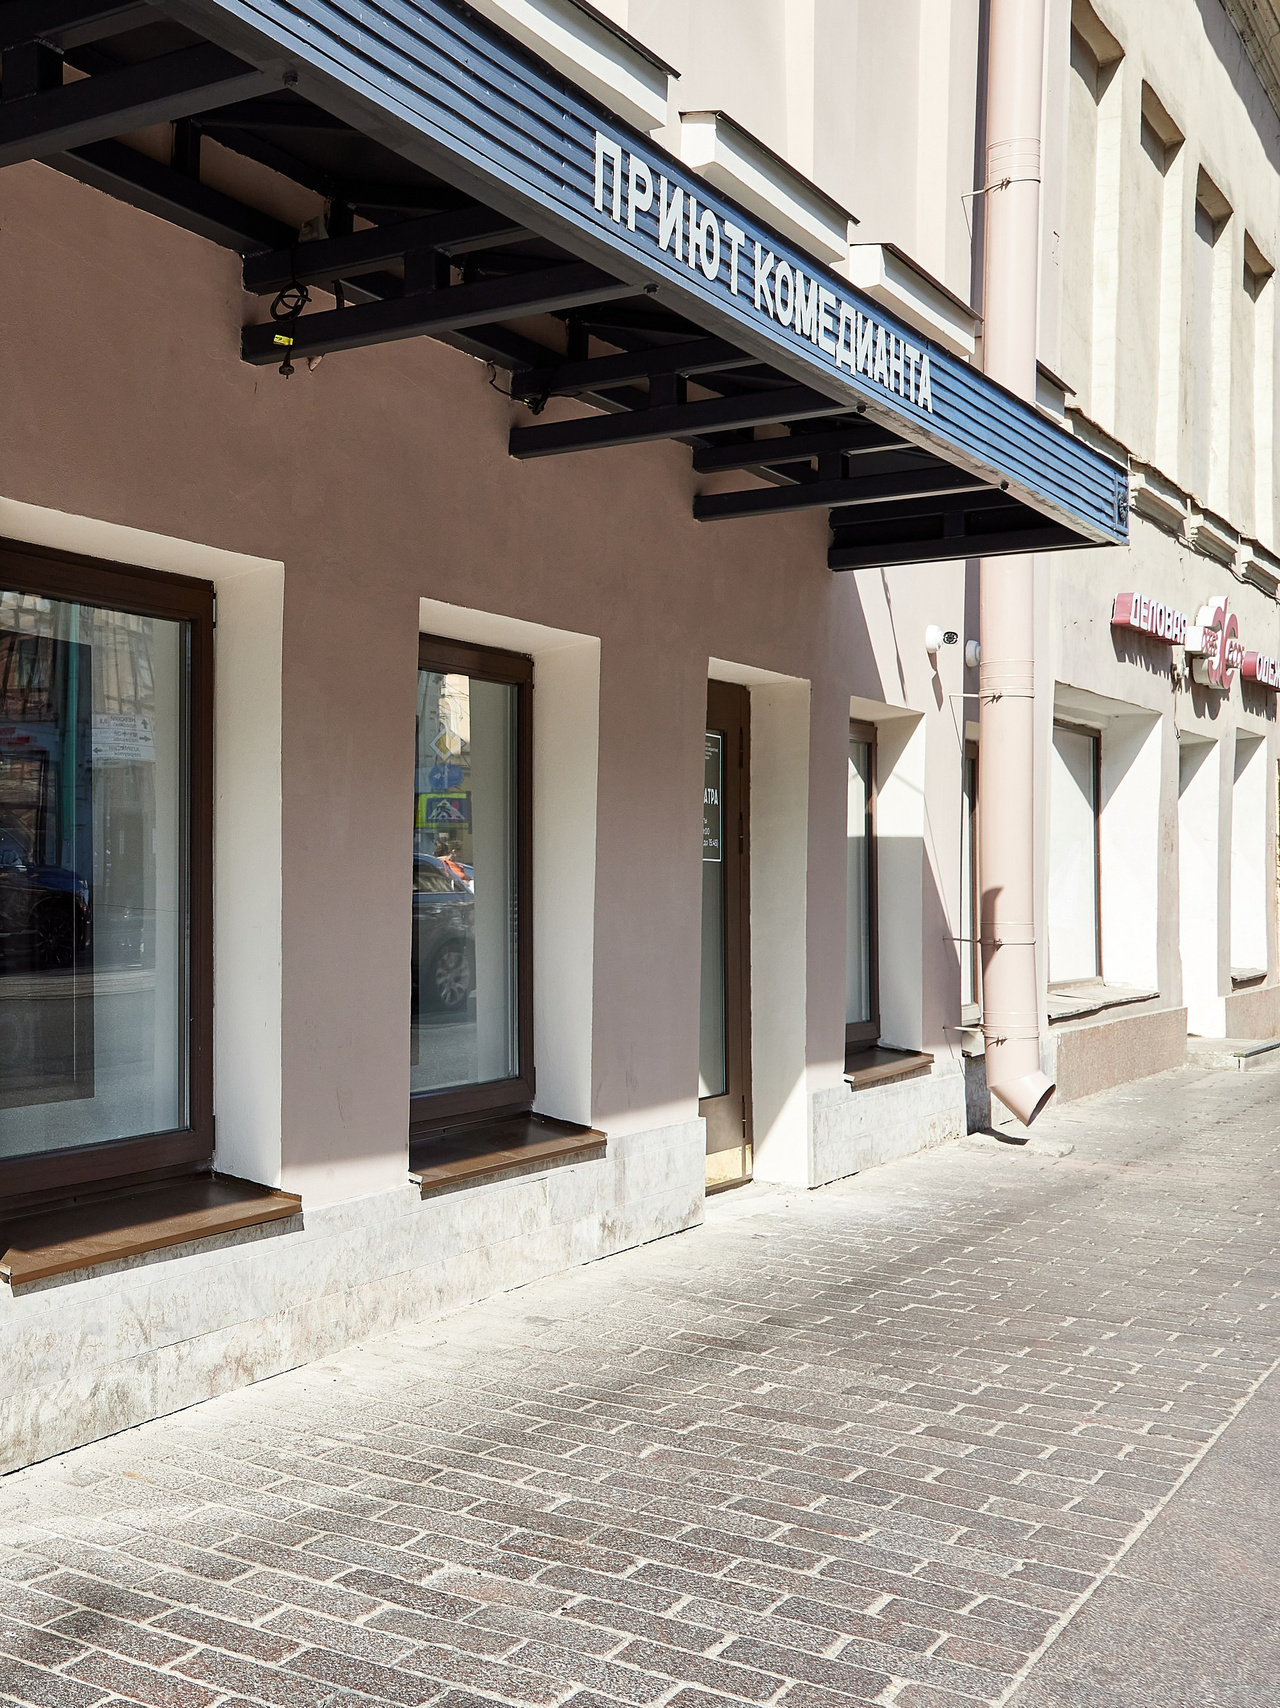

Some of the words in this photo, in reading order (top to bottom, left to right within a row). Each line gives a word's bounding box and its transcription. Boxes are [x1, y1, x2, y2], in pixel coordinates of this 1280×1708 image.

[594, 130, 745, 296] ПРИЮТ
[754, 242, 933, 414] КОМЕДИАНТА
[1130, 592, 1188, 645] ДЕЛОВАЯ
